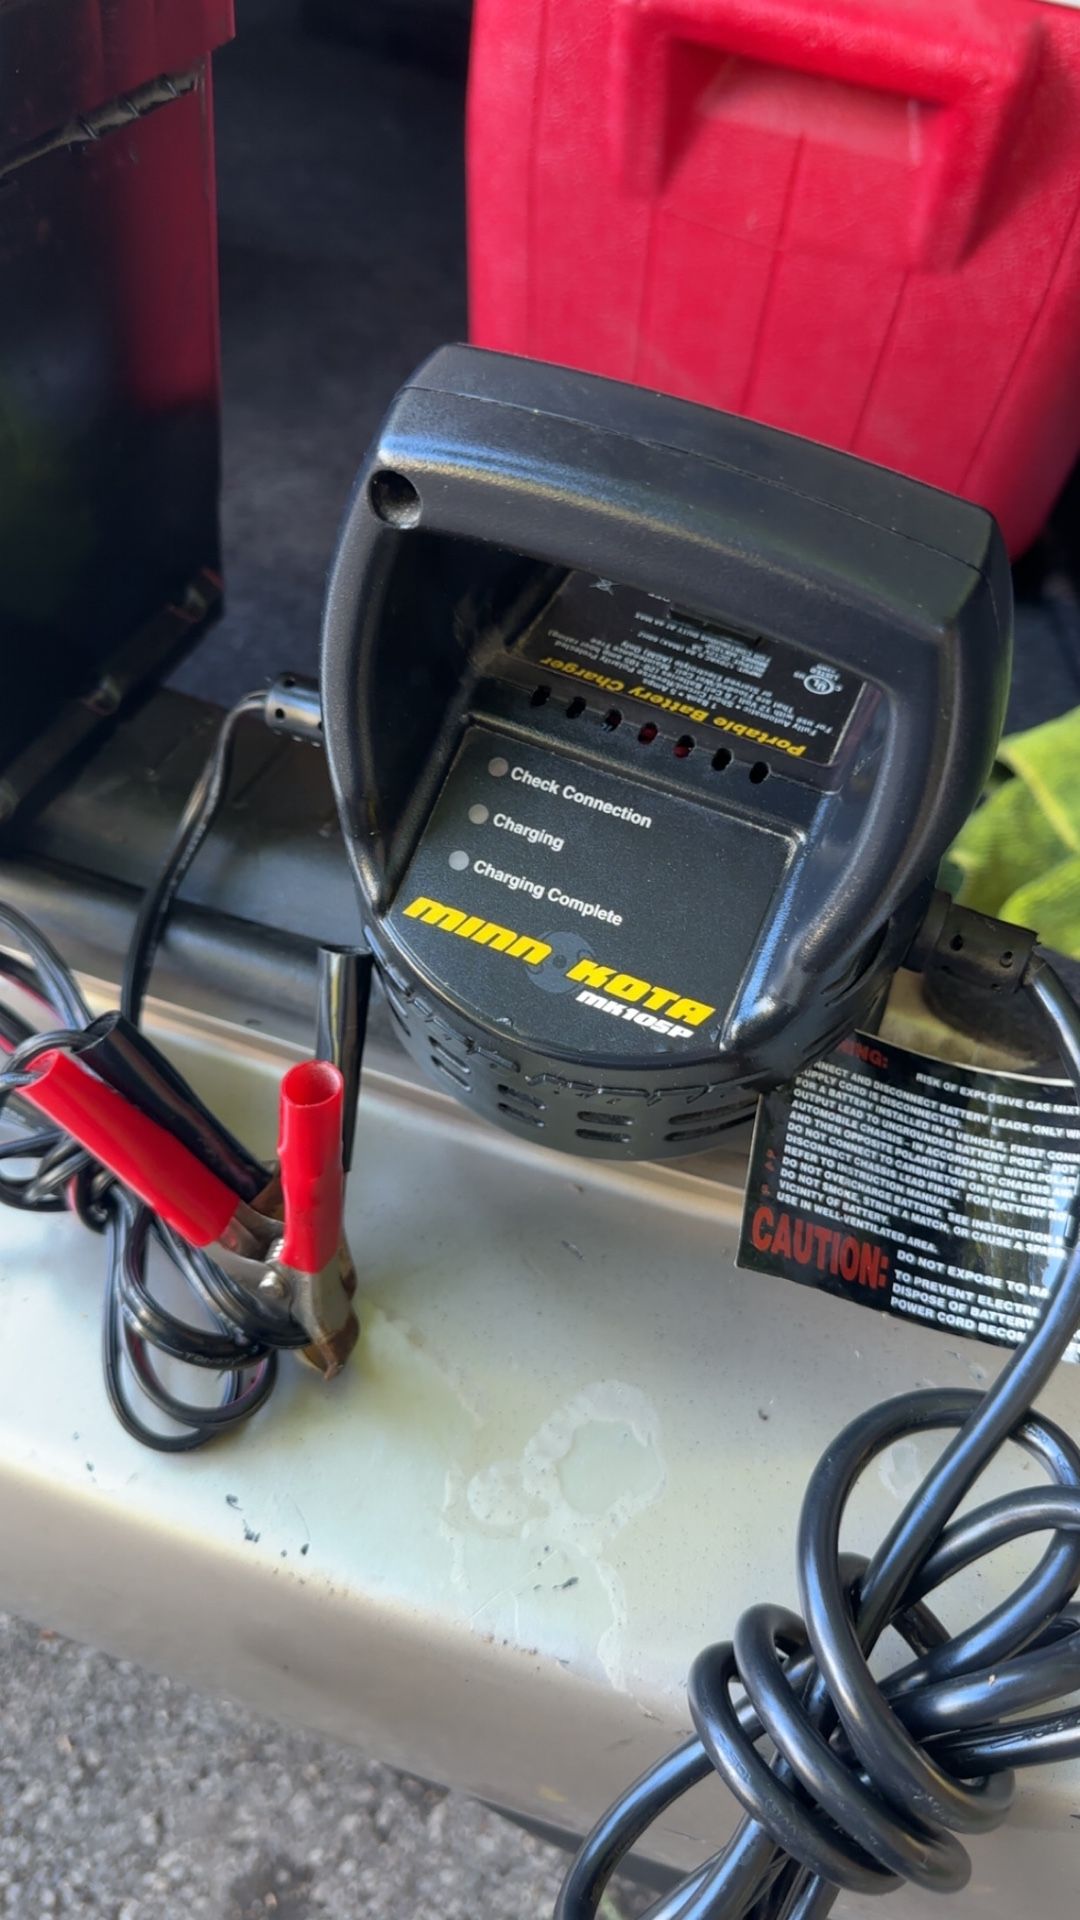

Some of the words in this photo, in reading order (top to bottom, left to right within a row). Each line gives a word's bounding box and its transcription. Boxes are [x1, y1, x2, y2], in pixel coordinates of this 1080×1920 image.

[554, 639, 597, 658] Protected
[590, 637, 610, 648] Free
[612, 645, 670, 670] Maintenance
[621, 640, 641, 651] Only
[539, 655, 624, 692] Charger
[599, 655, 634, 672] Polarity
[661, 670, 702, 688] Batteries
[642, 678, 667, 691] Amps
[686, 694, 708, 705] Bank
[703, 685, 720, 694] Cell
[708, 694, 733, 706] Short
[723, 676, 758, 693] Starved
[738, 697, 756, 707] Volt
[756, 695, 770, 703] are
[628, 686, 708, 722] Battery
[742, 706, 790, 726] Automatic
[773, 701, 793, 712] That
[773, 709, 793, 720] with
[796, 716, 814, 726] use
[713, 717, 806, 757] Portable
[792, 722, 816, 735] Fully
[816, 723, 831, 733] For
[511, 766, 559, 795] Check
[562, 785, 653, 828] Connection
[493, 813, 565, 852] Charging
[473, 859, 545, 899] Charging
[547, 888, 623, 926] Complete
[566, 958, 717, 1027] KOTA
[801, 1067, 837, 1085] UPPLY
[838, 1080, 867, 1095] CORD
[868, 1090, 879, 1101] IS
[880, 1095, 962, 1129] DISCONNECTED.
[850, 1072, 872, 1086] AND
[873, 1081, 937, 1108] DISCONNECT
[939, 1103, 989, 1123] BATTERY
[991, 1117, 1029, 1131] LEADS
[1032, 1125, 1063, 1137] ONLY
[915, 1072, 941, 1087] RISK
[943, 1081, 958, 1093] OF
[959, 1086, 1023, 1107] EXPLOSIVE
[1026, 1101, 1050, 1112] GAS
[793, 1088, 836, 1108] OUTPUT
[837, 1103, 864, 1118] LEAD
[866, 1113, 880, 1125] TO
[881, 1119, 953, 1149] UNGROUNDED
[955, 1142, 1005, 1162] BATTERY
[1008, 1155, 1041, 1168] POST
[1051, 1163, 1076, 1173] NOT
[795, 1076, 817, 1090] FOR
[818, 1084, 828, 1095] A
[828, 1087, 874, 1110] BATTERY
[874, 1105, 930, 1129] INSTALLED
[931, 1124, 944, 1135] IN
[945, 1128, 954, 1138] A
[955, 1131, 1007, 1151] VEHICLE,
[1010, 1144, 1044, 1157] FIRST
[789, 1110, 812, 1124] AND
[813, 1119, 842, 1135] THEN
[843, 1129, 894, 1152] OPPOSITE
[894, 1147, 946, 1170] POLARITY
[947, 1164, 977, 1179] LEAD
[979, 1173, 996, 1184] TO
[998, 1177, 1050, 1194] CHASSIS
[791, 1100, 858, 1128] AUTOMOBILE
[859, 1123, 903, 1144] CHASSIS
[911, 1141, 924, 1152] IN
[925, 1145, 1000, 1173] ACCORDANCE
[1003, 1166, 1035, 1179] WITH
[783, 1145, 818, 1162] REFER
[820, 1157, 836, 1169] TO
[836, 1163, 905, 1192] INSTRUCTION
[906, 1186, 954, 1210] MANUAL.
[785, 1134, 853, 1162] DISCONNECT
[853, 1157, 897, 1178] CHASSIS
[898, 1173, 926, 1188] LEAD
[927, 1182, 961, 1198] FIRST.
[966, 1193, 989, 1206] FOR
[992, 1200, 1045, 1217] BATTERY
[787, 1122, 803, 1134] DO
[804, 1128, 827, 1141] NOT
[828, 1136, 878, 1159] CONNECT
[879, 1154, 893, 1165] TO
[894, 1159, 966, 1188] CARBURETOR
[968, 1182, 985, 1194] OR
[988, 1186, 1018, 1200] FUEL
[778, 1179, 824, 1201] VICINITY
[826, 1196, 841, 1208] OF
[841, 1202, 891, 1224] BATTERY.
[780, 1168, 796, 1180] DO
[797, 1174, 820, 1187] NOT
[821, 1182, 862, 1202] SMOKE,
[862, 1196, 900, 1215] STRIKE
[901, 1210, 909, 1219] A
[910, 1213, 951, 1232] MATCH,
[953, 1226, 970, 1238] OR
[971, 1231, 1012, 1247] CAUSE
[1014, 1241, 1025, 1251] A
[782, 1156, 797, 1168] DO
[799, 1162, 822, 1175] NOT
[823, 1170, 893, 1200] OVERCHARGE
[893, 1194, 943, 1217] BATTERY.
[947, 1212, 970, 1225] SEE
[971, 1218, 1050, 1242] INSTRUCTION
[776, 1191, 798, 1205] USE
[800, 1199, 812, 1211] IN
[813, 1204, 906, 1241] WELL-VENTILATED
[907, 1236, 939, 1252] AREA.
[752, 1206, 889, 1289] CAUTION:
[893, 1269, 912, 1282] TO
[913, 1276, 975, 1301] PREVENT
[896, 1249, 915, 1263] DO
[917, 1257, 944, 1272] NOT
[947, 1265, 1003, 1288] EXPOSE
[1005, 1280, 1027, 1293] TO
[1029, 1286, 1050, 1299] RA
[890, 1296, 935, 1318] POWER
[936, 1311, 976, 1330] CORD
[891, 1283, 946, 1307] DISPOSE
[947, 1300, 968, 1313] OF
[970, 1307, 1034, 1329] BATTERY
